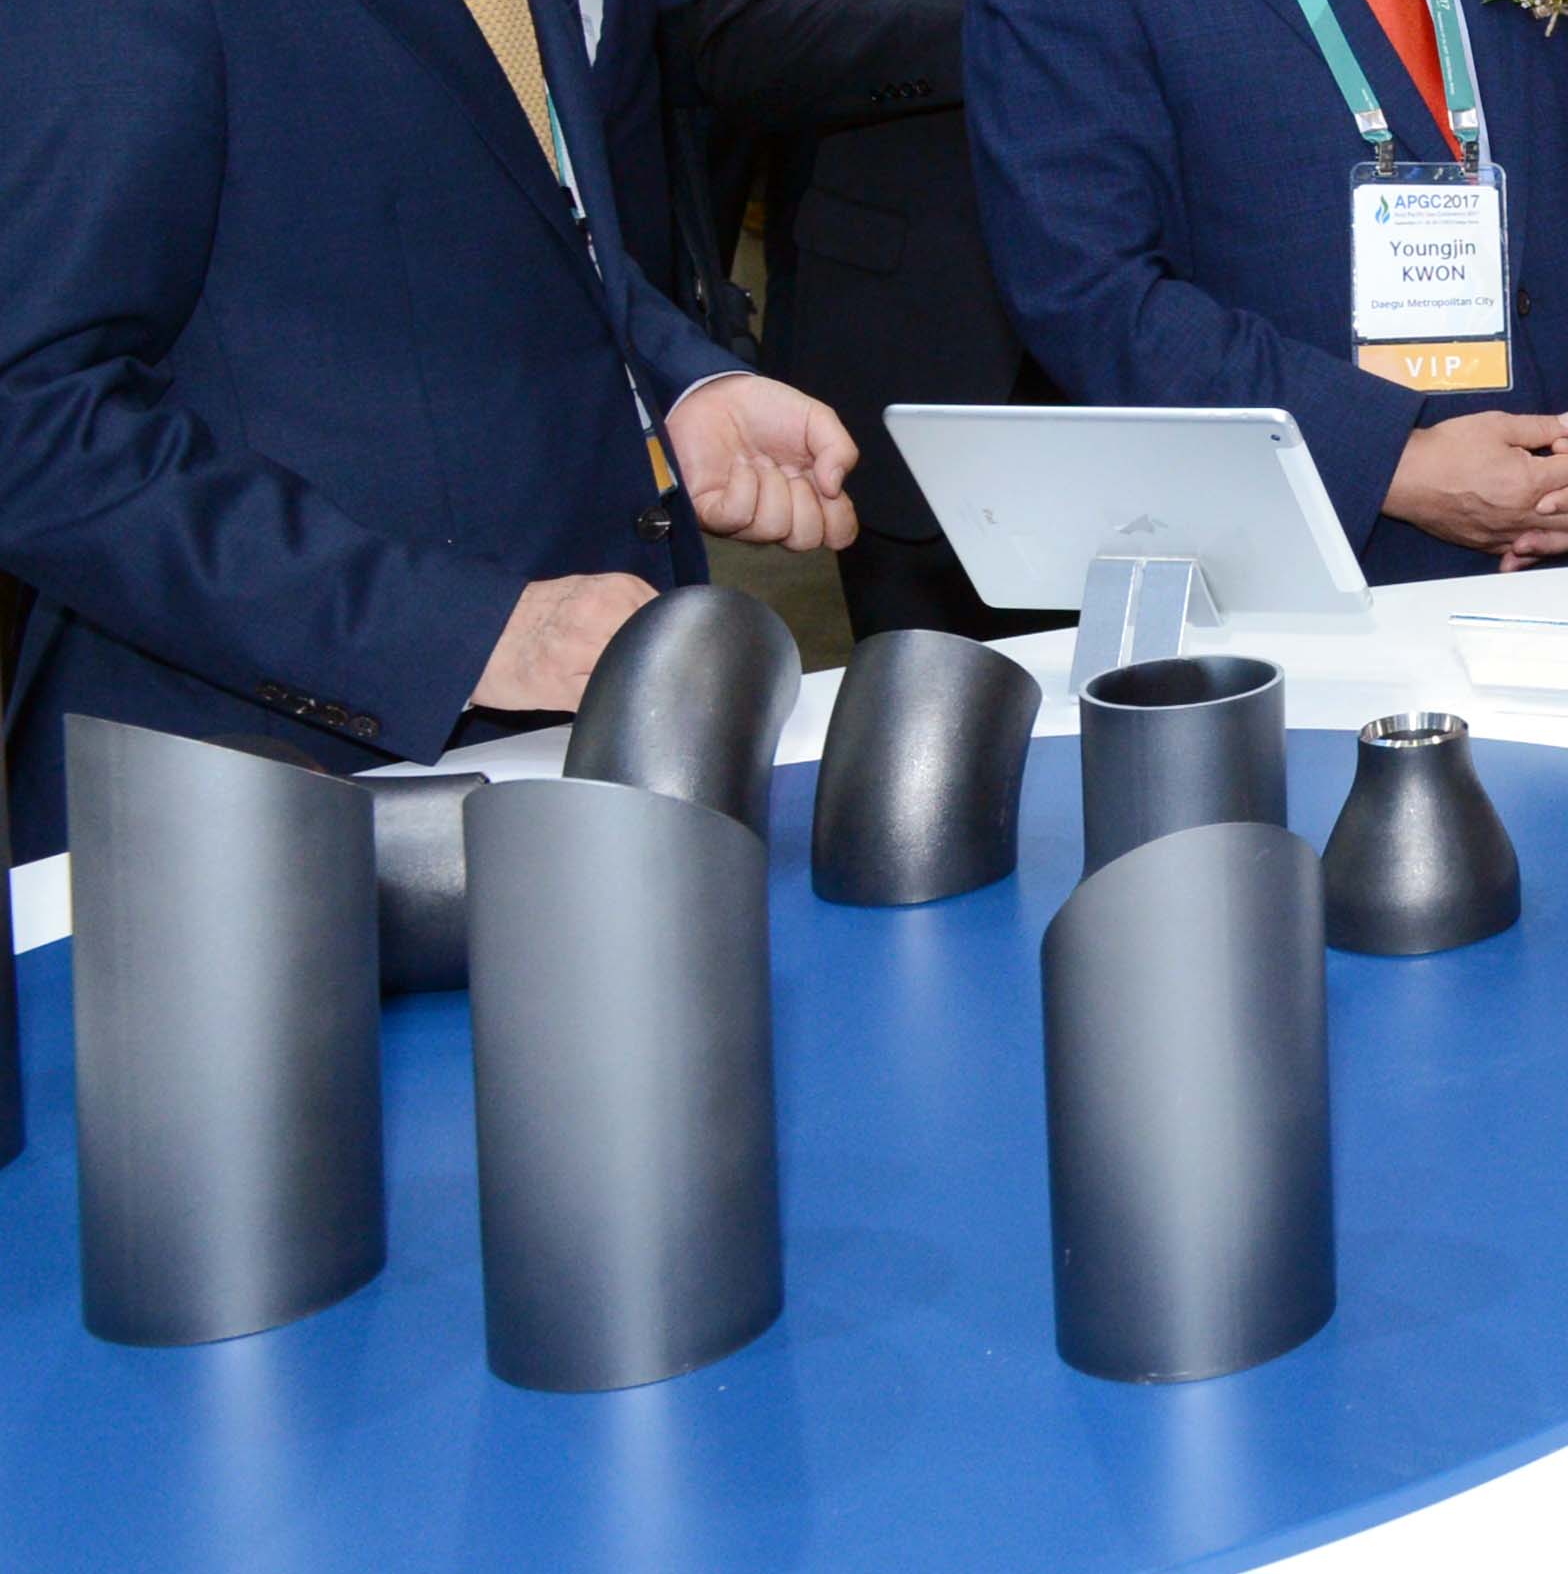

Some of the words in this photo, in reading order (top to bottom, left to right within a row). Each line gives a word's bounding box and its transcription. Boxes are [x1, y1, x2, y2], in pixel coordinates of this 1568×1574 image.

[1394, 194, 1480, 209] APGC2017
[1389, 239, 1476, 260] Youngjin
[1402, 265, 1465, 282] KWON
[1371, 299, 1404, 310] Daegu
[1407, 297, 1472, 309] Metropolitan
[1475, 297, 1494, 307] City
[1405, 356, 1461, 377] VIP
